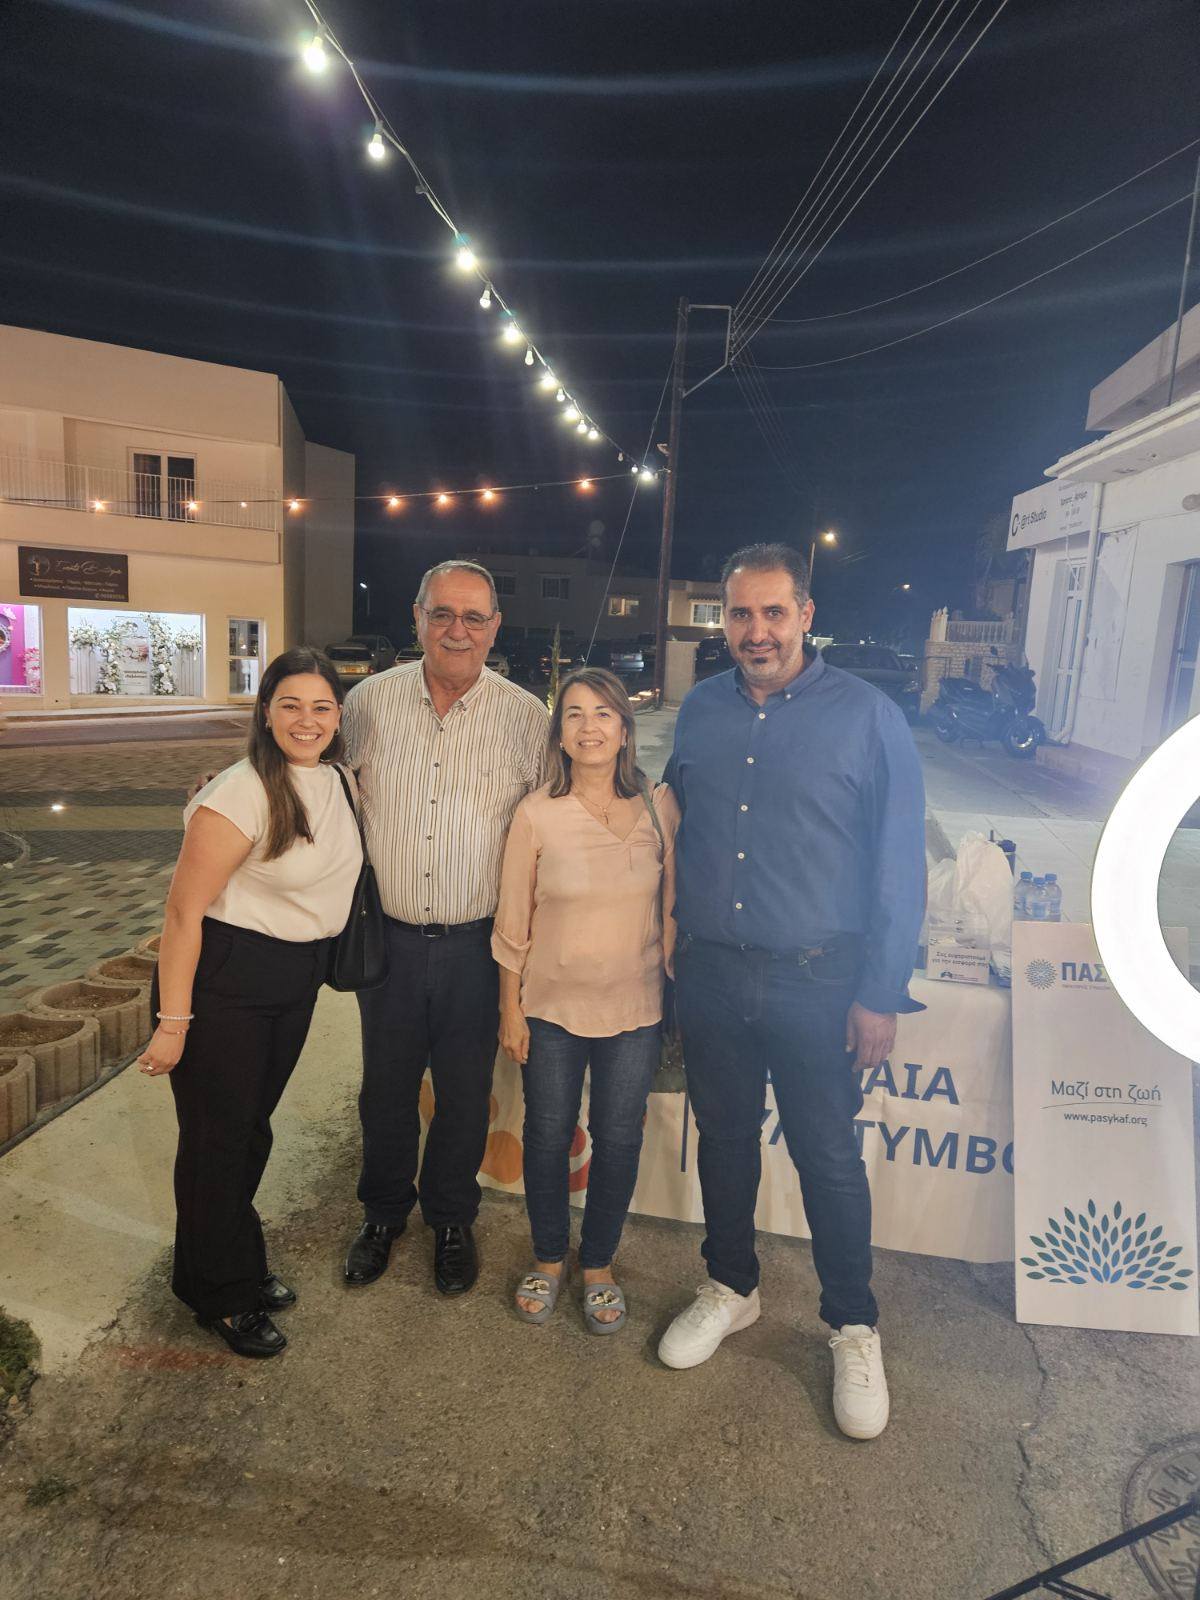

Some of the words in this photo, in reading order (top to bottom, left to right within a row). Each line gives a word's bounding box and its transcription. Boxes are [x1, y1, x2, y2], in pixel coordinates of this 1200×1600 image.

[1061, 962, 1107, 982] ΠΑΣ
[862, 1059, 960, 1106] ΑΙΑ
[1051, 1080, 1089, 1100] Μαζί
[1094, 1086, 1122, 1099] στη
[1128, 1084, 1161, 1102] ζωή
[1063, 1112, 1148, 1127] www.pasykaf.org
[853, 1118, 1014, 1175] ΤΥΜΒ
